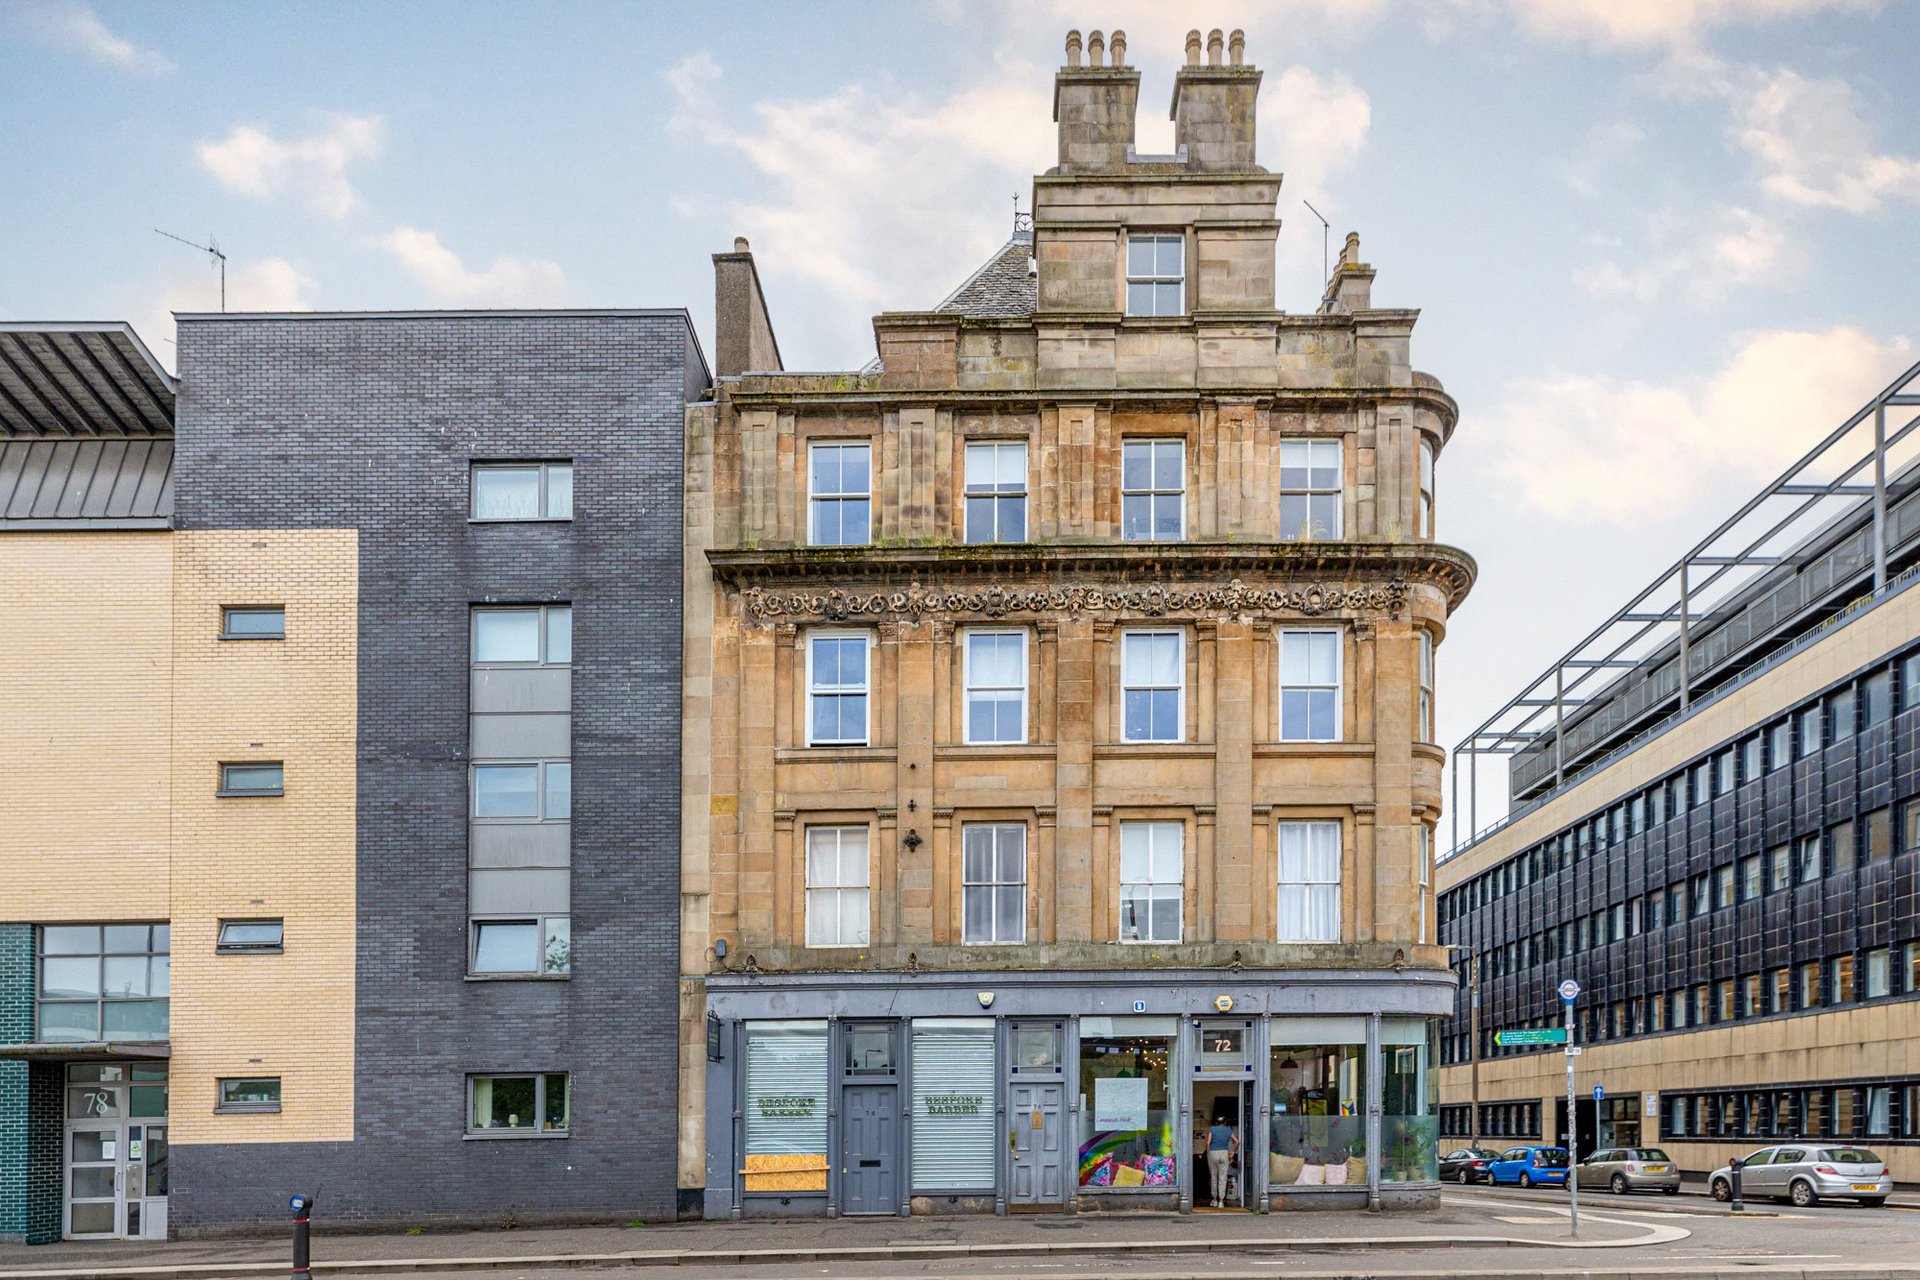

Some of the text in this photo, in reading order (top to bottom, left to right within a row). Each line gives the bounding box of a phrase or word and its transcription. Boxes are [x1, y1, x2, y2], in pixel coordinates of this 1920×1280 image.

[1215, 1039, 1231, 1052] 72
[84, 1092, 108, 1113] 78
[925, 1096, 982, 1104] BESPOKE
[928, 1106, 979, 1114] BARBER
